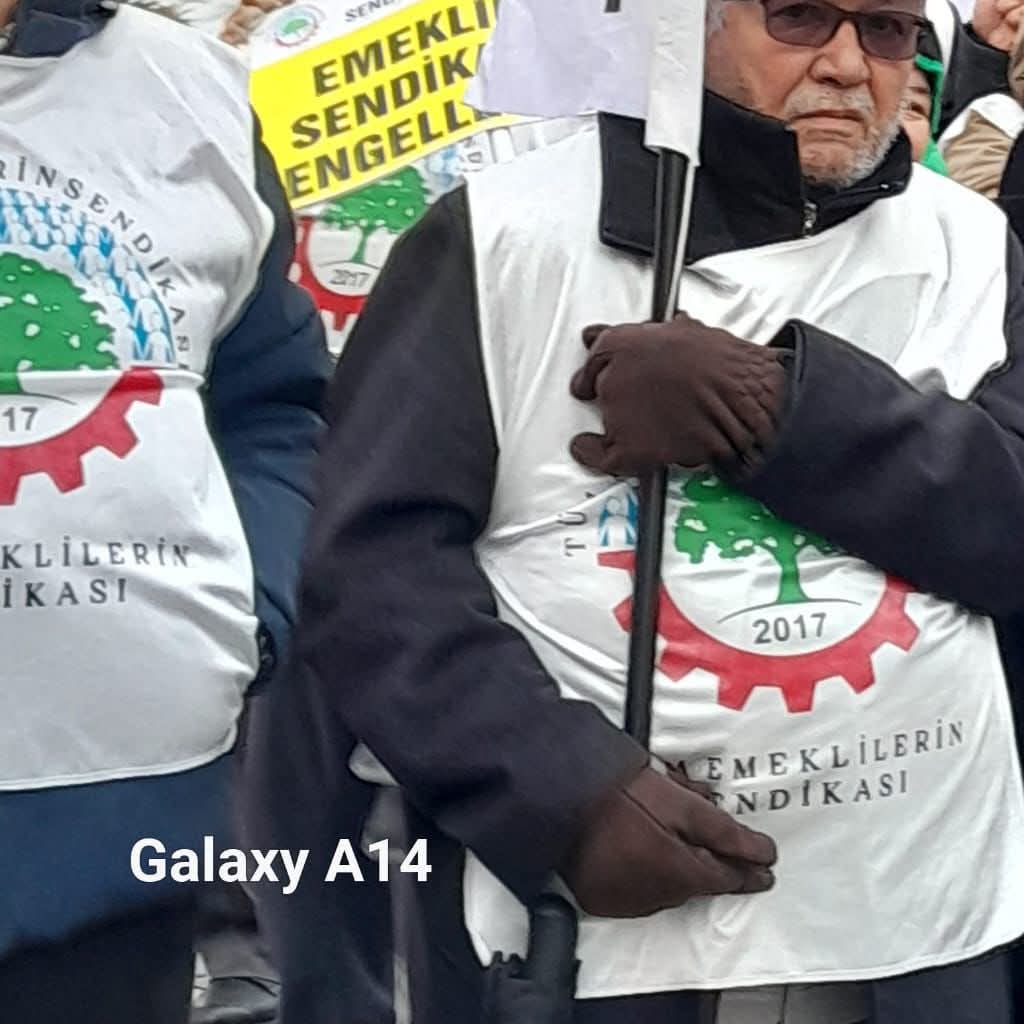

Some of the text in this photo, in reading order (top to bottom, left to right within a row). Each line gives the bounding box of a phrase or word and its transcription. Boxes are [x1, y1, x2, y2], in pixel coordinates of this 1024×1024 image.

[291, 43, 486, 150] SENDİK
[284, 100, 502, 199] ENGELL
[752, 613, 827, 645] 2017
[708, 718, 964, 782] EMEKLİLERİN
